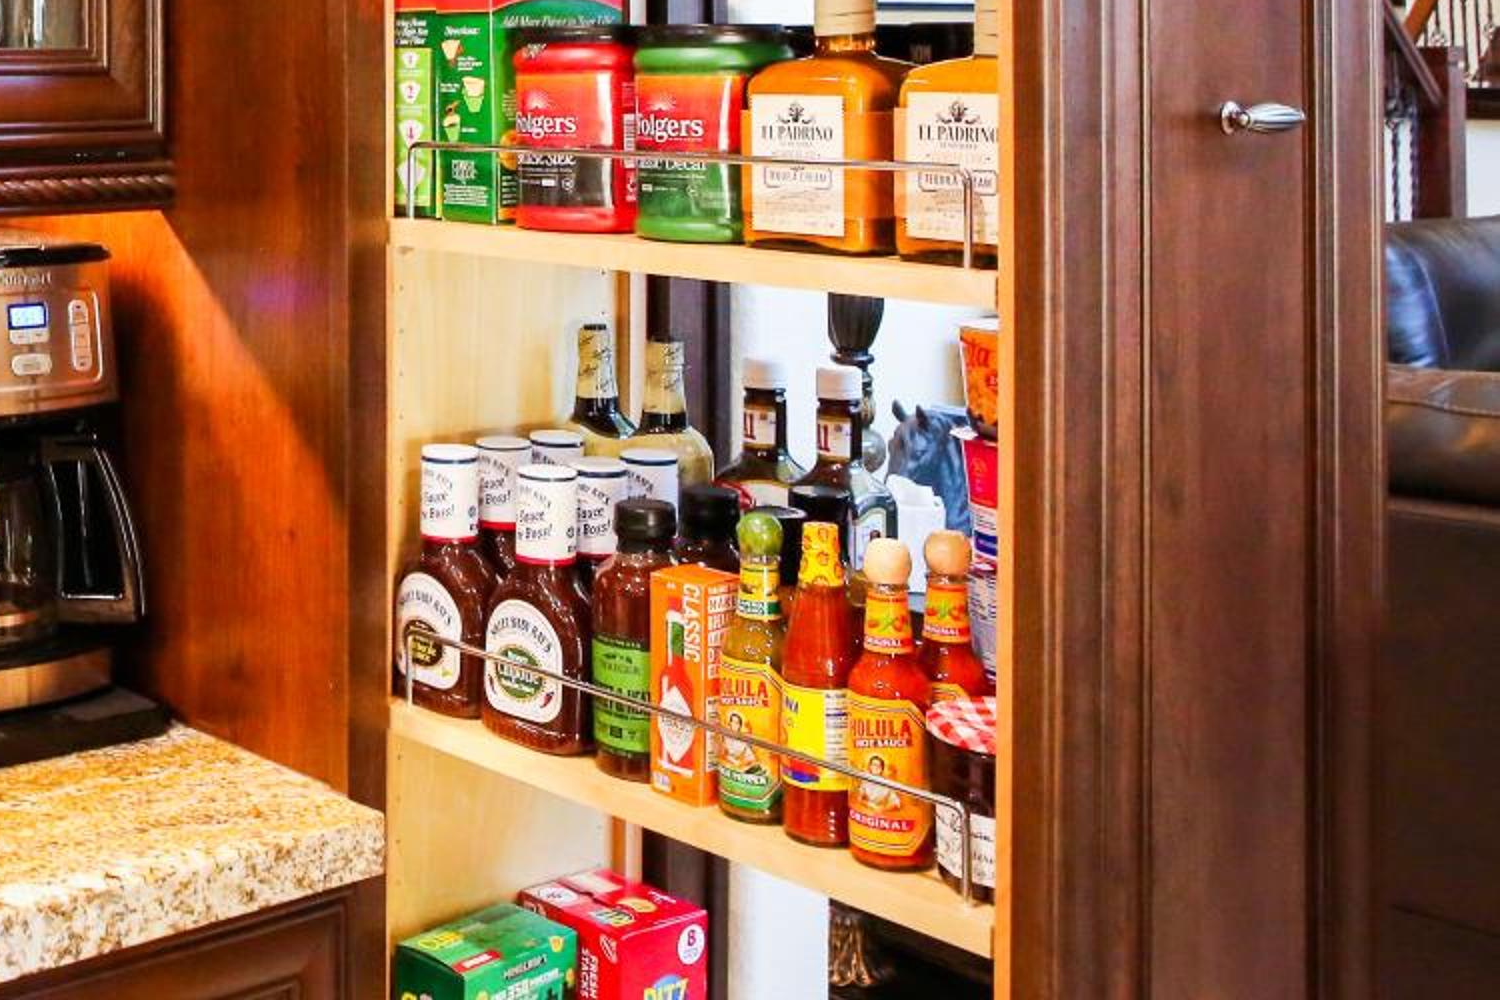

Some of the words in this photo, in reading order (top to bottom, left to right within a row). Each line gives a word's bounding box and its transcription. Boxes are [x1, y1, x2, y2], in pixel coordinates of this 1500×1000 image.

[777, 125, 834, 142] PADRINO
[683, 583, 701, 664] CLASSIC
[849, 808, 907, 831] ORIGINAL
